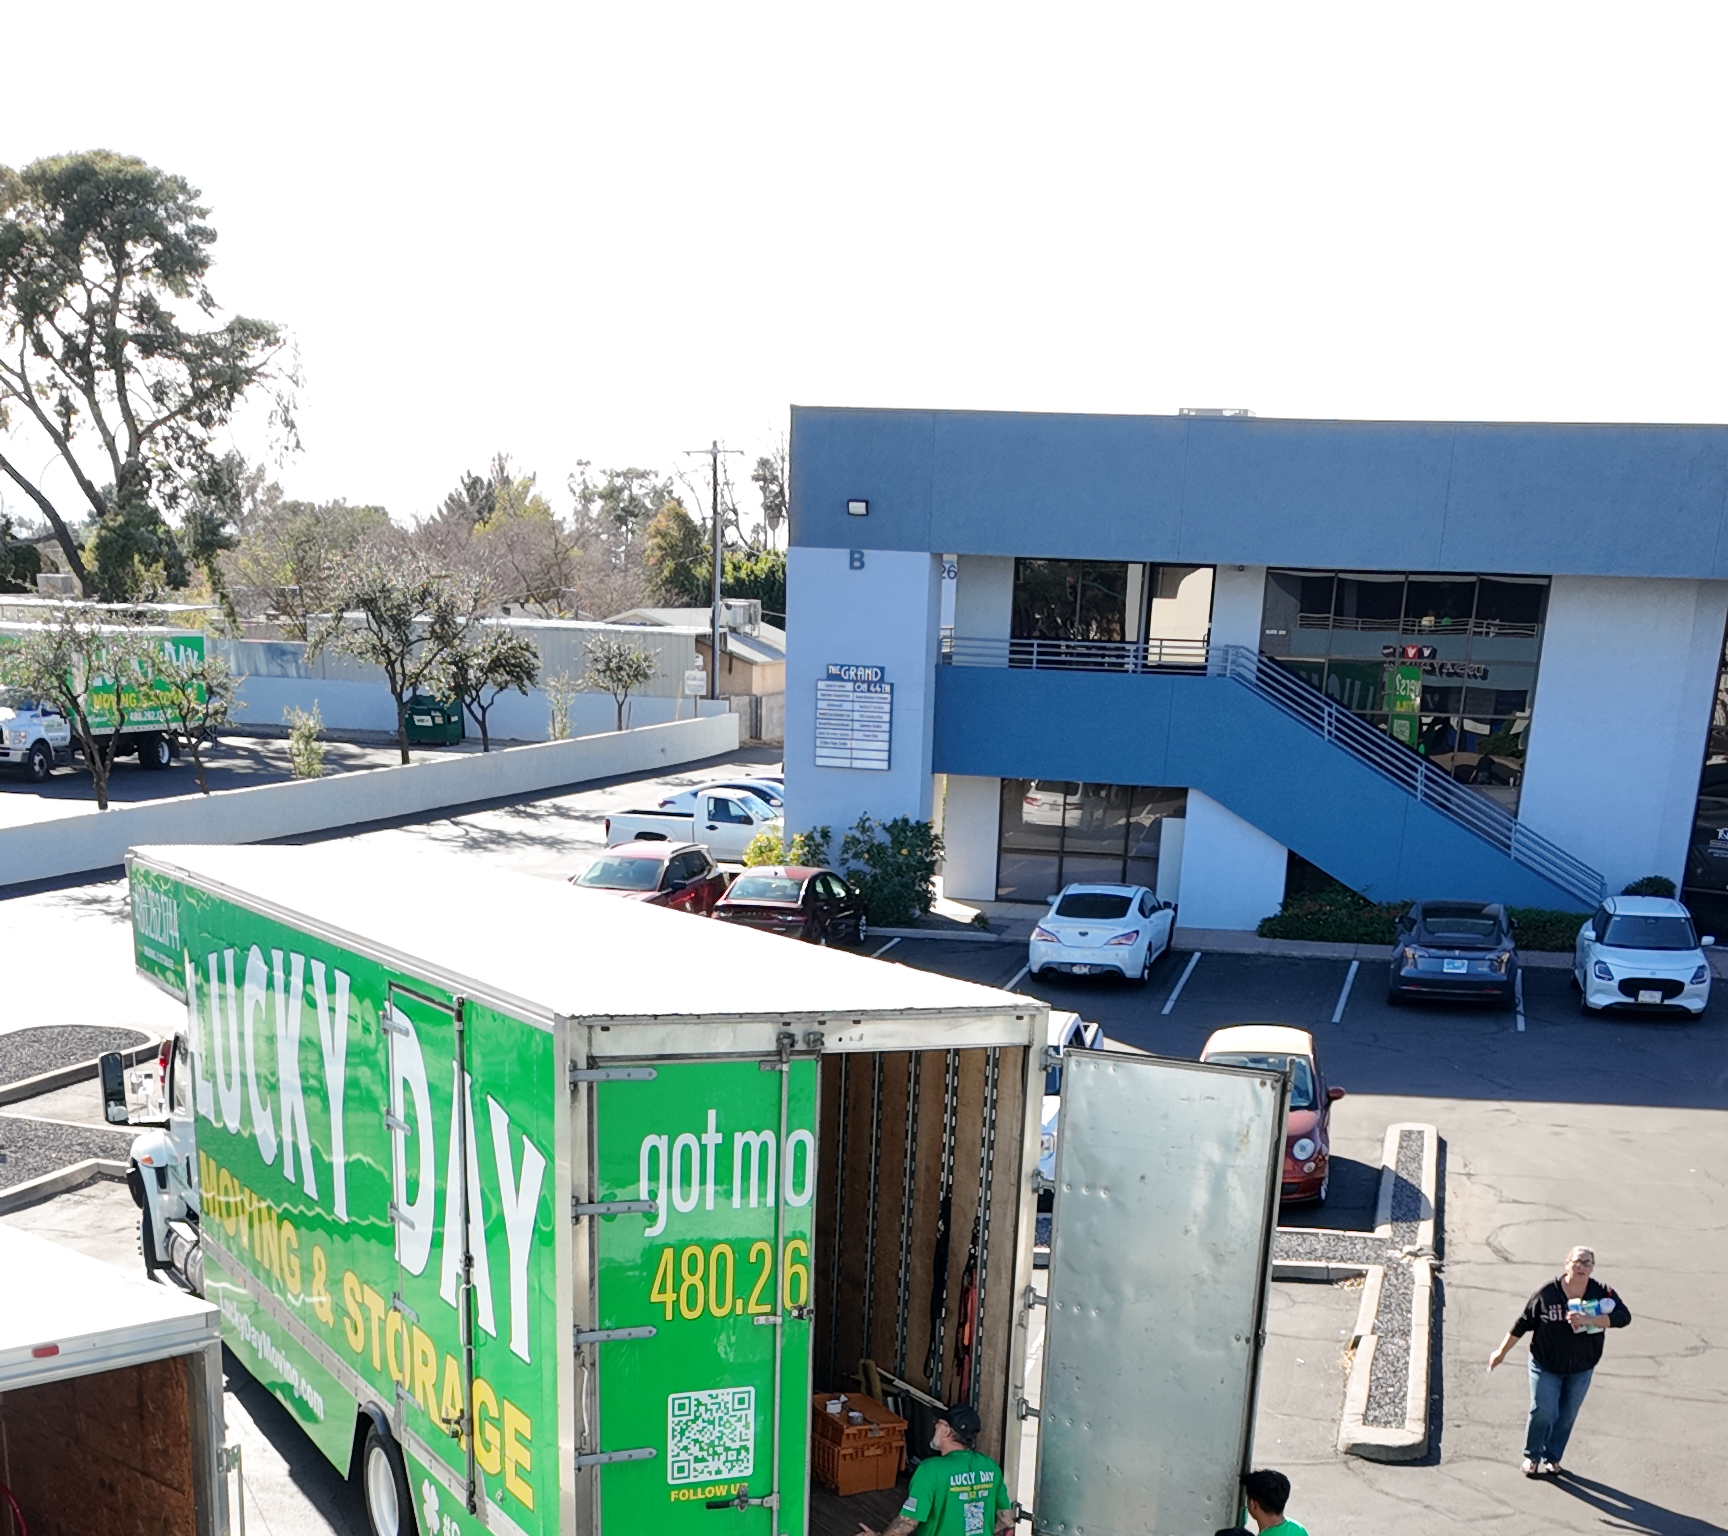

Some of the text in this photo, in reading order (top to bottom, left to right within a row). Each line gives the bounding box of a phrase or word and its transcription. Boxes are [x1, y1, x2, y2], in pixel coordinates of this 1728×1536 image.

[849, 549, 865, 571] B
[840, 665, 882, 682] GRAND
[93, 692, 137, 709] MOVNG
[188, 942, 546, 1367] LUCKY DAY
[639, 1108, 815, 1238] got mo
[649, 1238, 810, 1322] 480.26
[199, 1150, 536, 1512] MOVING & STORAGE
[220, 1288, 325, 1422] LuckyDayMoving.com
[670, 1481, 749, 1503] FOLLOW U
[979, 1470, 995, 1483] DAY
